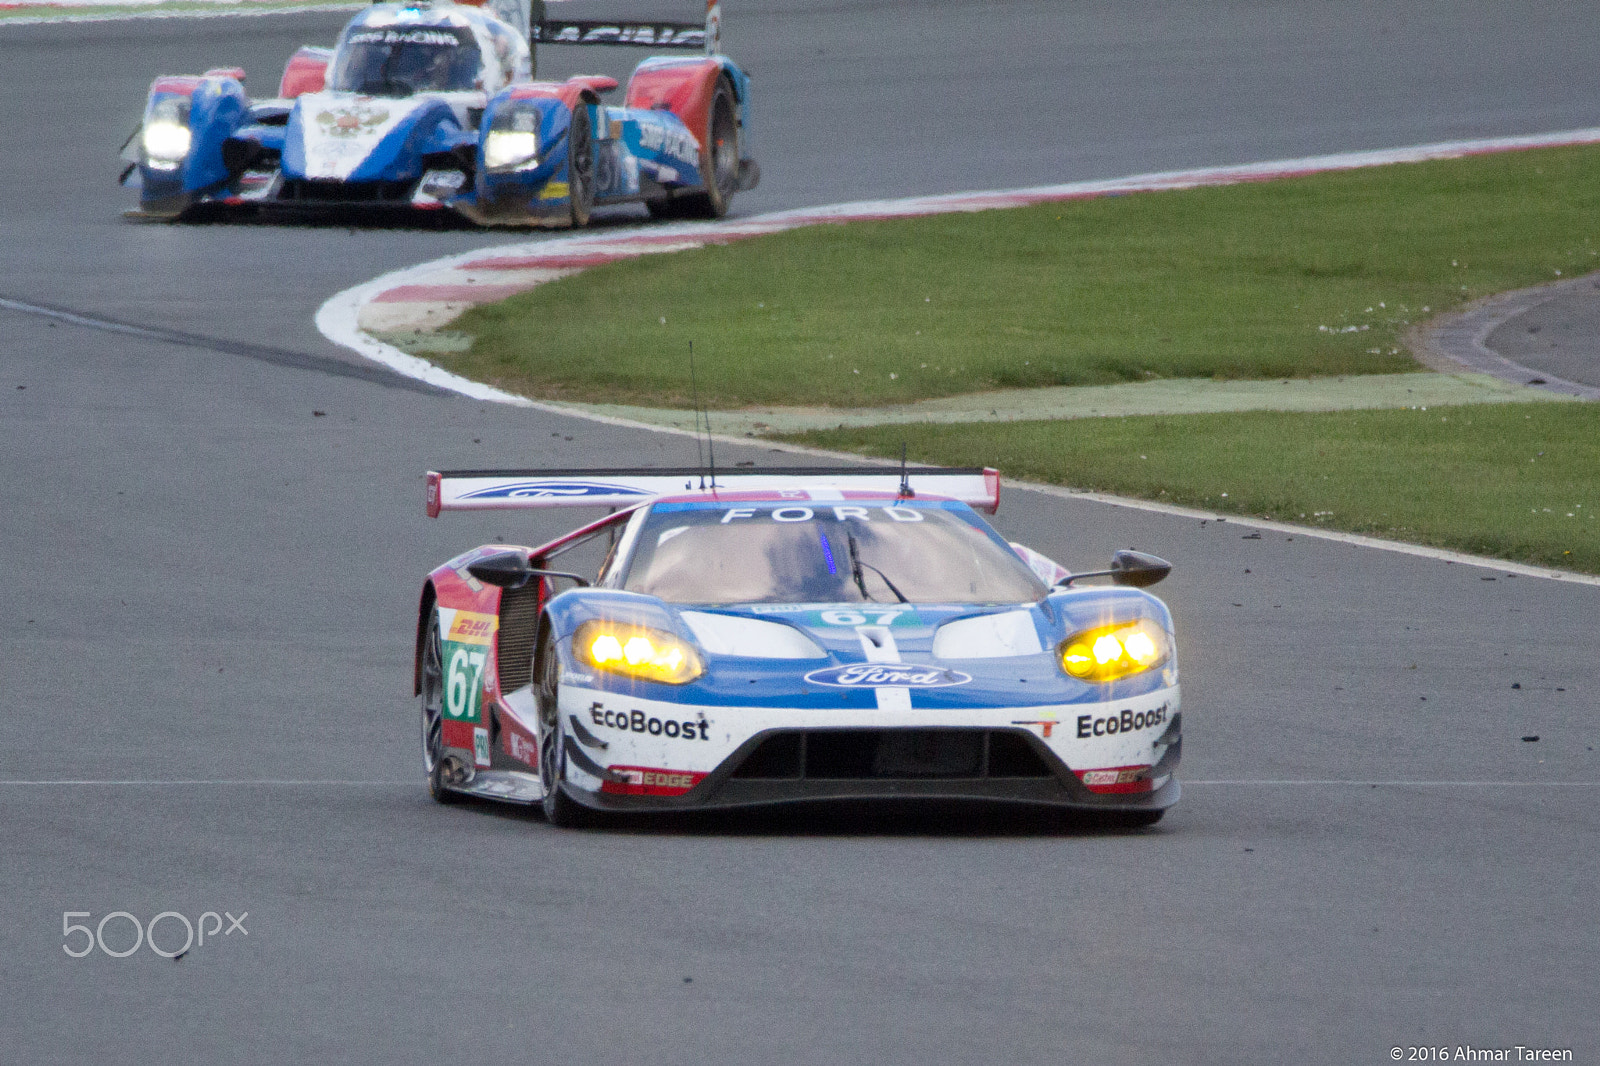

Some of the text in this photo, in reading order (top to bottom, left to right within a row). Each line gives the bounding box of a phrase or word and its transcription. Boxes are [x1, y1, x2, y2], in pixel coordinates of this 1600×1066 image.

[720, 505, 925, 523] FORD
[820, 610, 903, 626] 67
[457, 618, 491, 638] DHL
[447, 648, 485, 718] 67
[837, 665, 939, 684] Ford
[590, 701, 710, 741] EcoBoost
[1077, 702, 1168, 739] EcoBoost
[643, 771, 694, 788] EDGE
